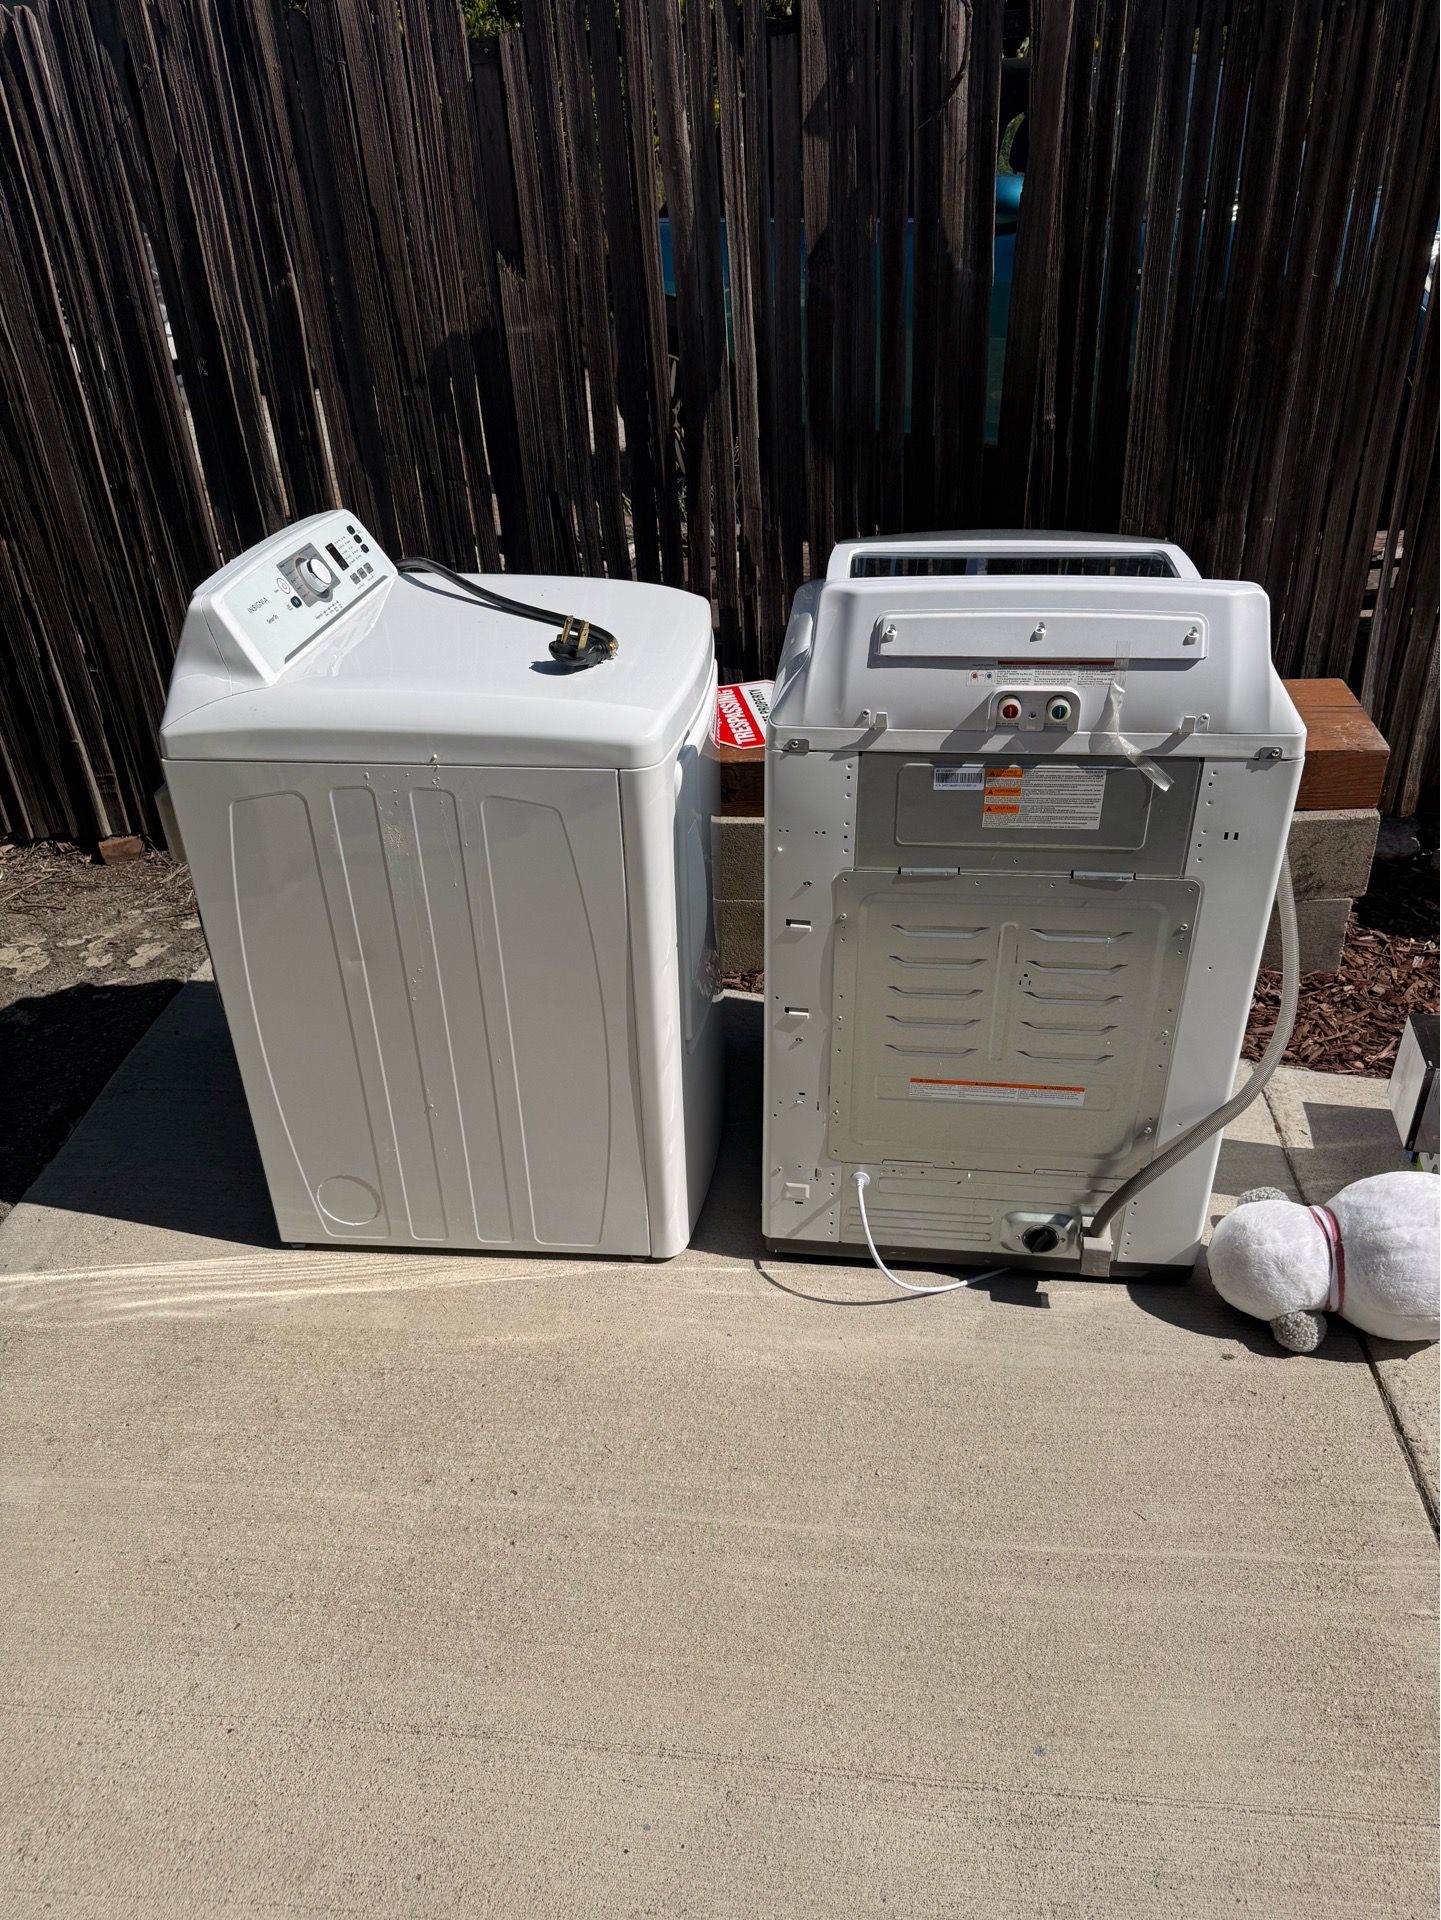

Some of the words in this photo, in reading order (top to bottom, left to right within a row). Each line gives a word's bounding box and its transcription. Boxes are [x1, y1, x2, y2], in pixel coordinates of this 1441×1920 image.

[248, 597, 268, 613] INSIGNIA
[748, 689, 769, 715] PROPERTY
[718, 689, 757, 745] TRESPASSING
